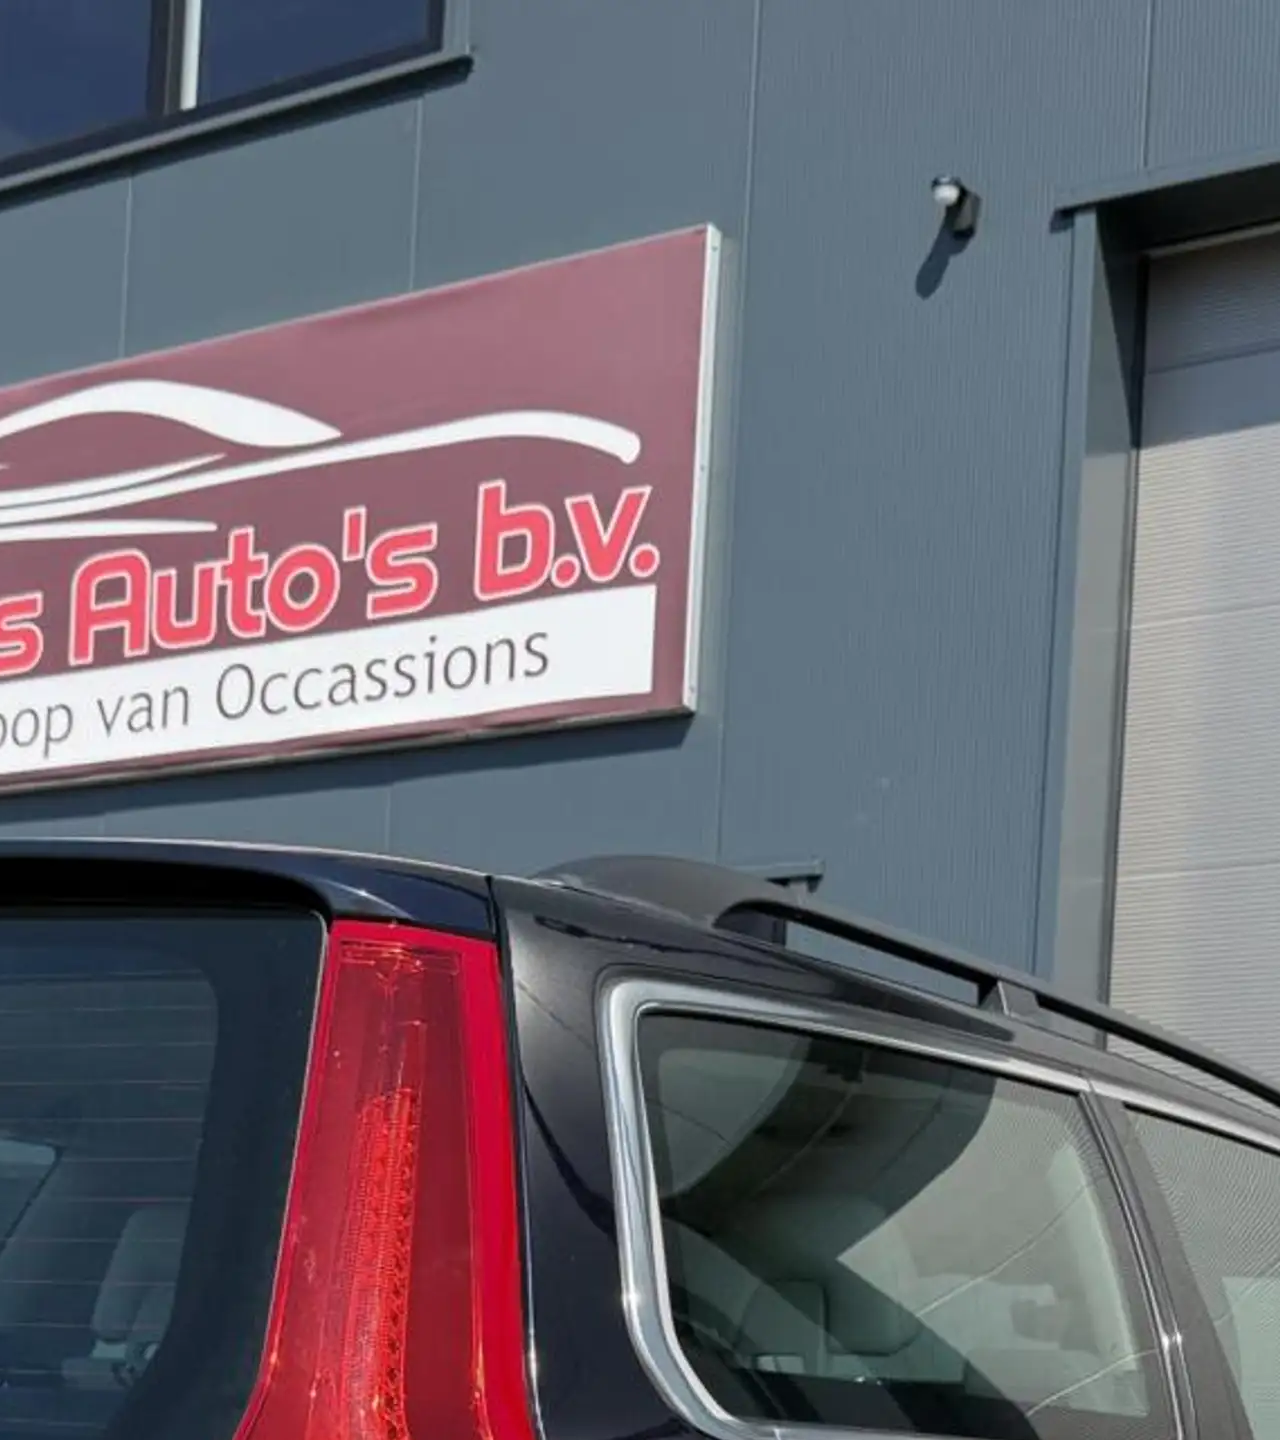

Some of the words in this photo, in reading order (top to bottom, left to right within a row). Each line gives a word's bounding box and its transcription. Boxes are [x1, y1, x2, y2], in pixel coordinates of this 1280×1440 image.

[68, 505, 440, 666] Auto's
[473, 480, 661, 603] b.v.
[94, 684, 192, 737] van
[215, 629, 551, 723] Occassions
